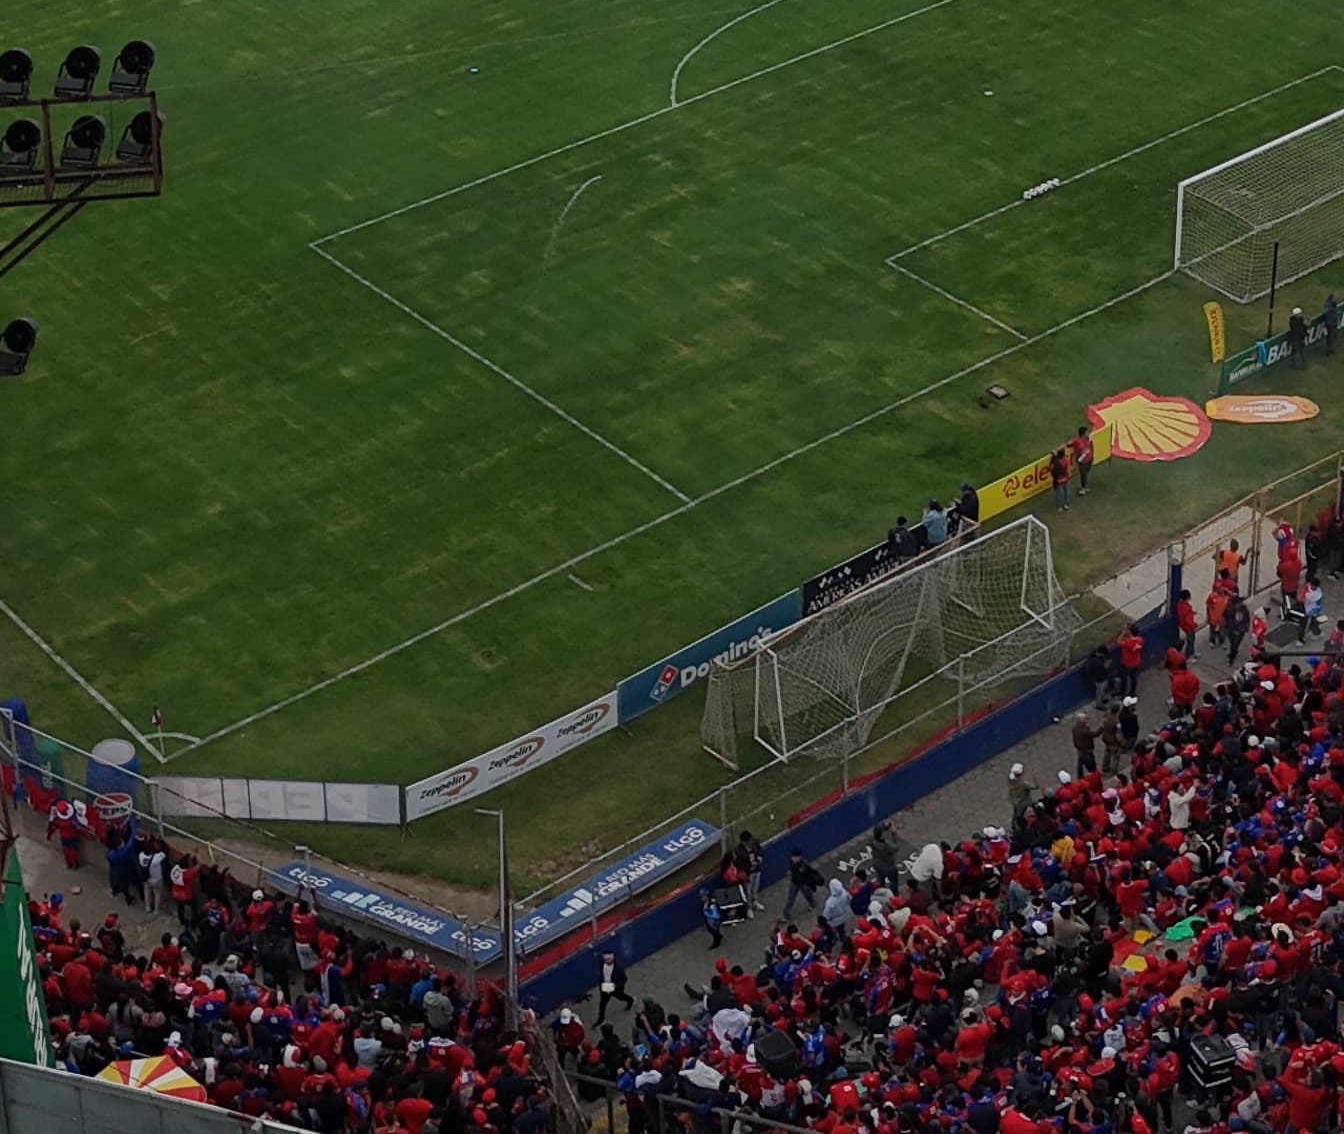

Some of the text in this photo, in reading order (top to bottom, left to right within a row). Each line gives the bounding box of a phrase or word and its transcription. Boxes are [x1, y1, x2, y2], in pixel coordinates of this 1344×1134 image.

[679, 625, 776, 689] Domino's
[663, 827, 705, 853] tigo
[598, 856, 665, 898] GRANDE
[368, 904, 443, 936] GRANDE
[377, 900, 394, 911] LA
[394, 905, 418, 920] RED
